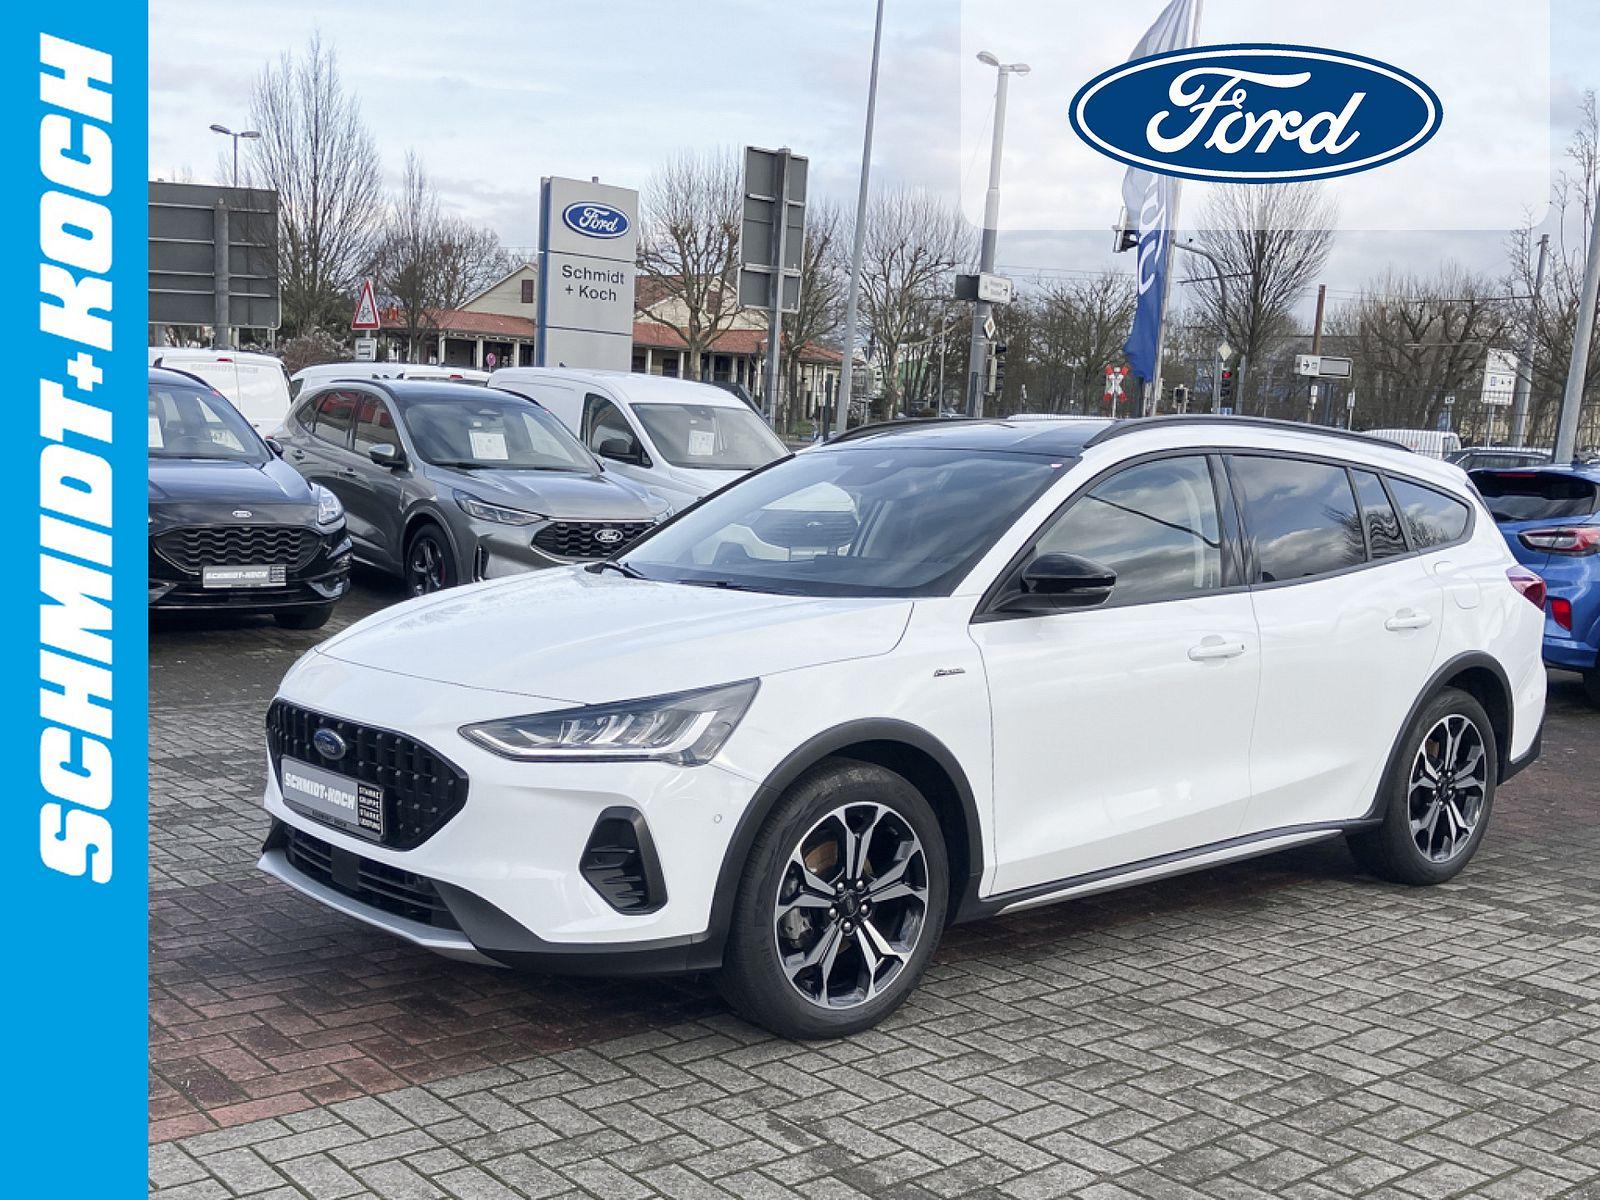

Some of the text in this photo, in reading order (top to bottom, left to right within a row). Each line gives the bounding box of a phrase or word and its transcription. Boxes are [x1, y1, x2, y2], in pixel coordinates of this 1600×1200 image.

[579, 207, 618, 232] Ford
[562, 264, 625, 285] Schmidt
[565, 284, 617, 302] + Koch
